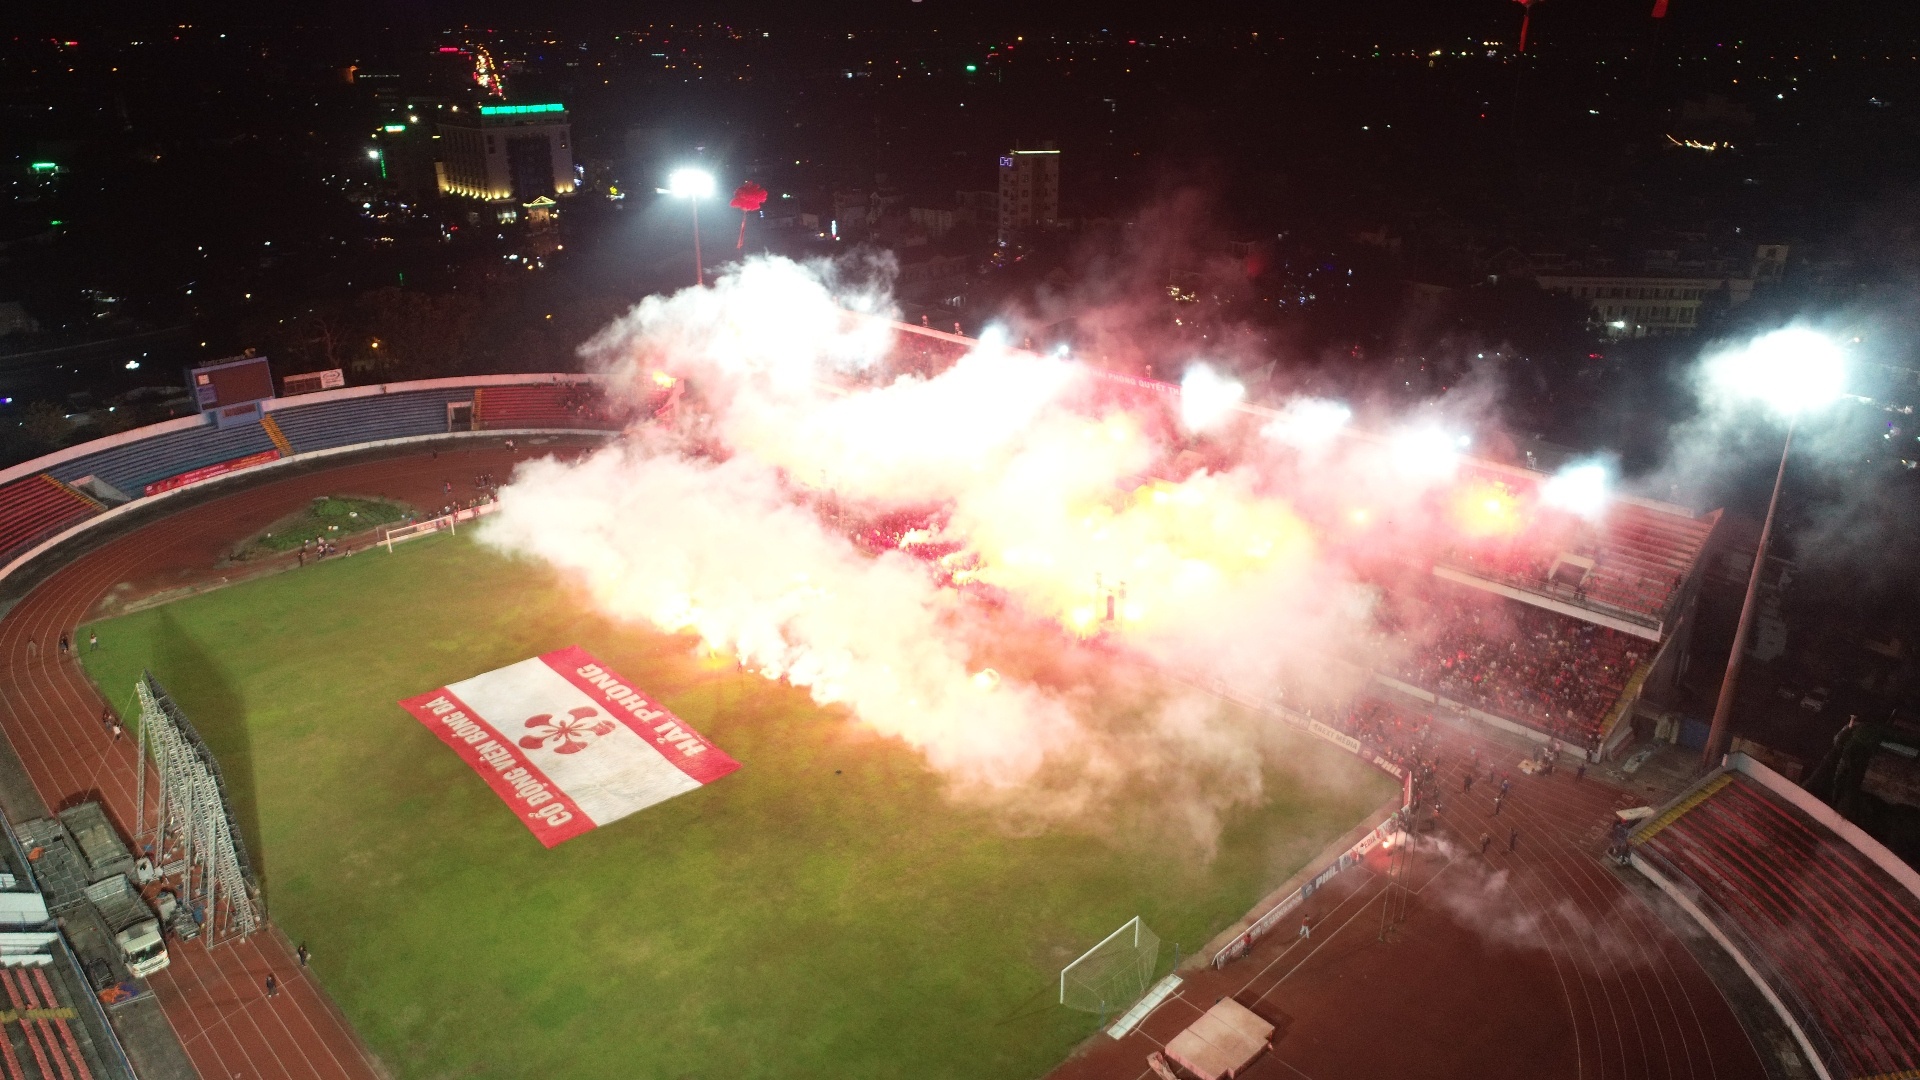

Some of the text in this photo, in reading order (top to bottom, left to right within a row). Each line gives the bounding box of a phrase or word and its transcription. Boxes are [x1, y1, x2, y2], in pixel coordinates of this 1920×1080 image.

[577, 664, 707, 758] HẢI PHÒNG
[1335, 733, 1358, 750] MEDIA
[421, 696, 572, 826] CỔ ĐỘNG VIÊN BÓNG ĐÁ
